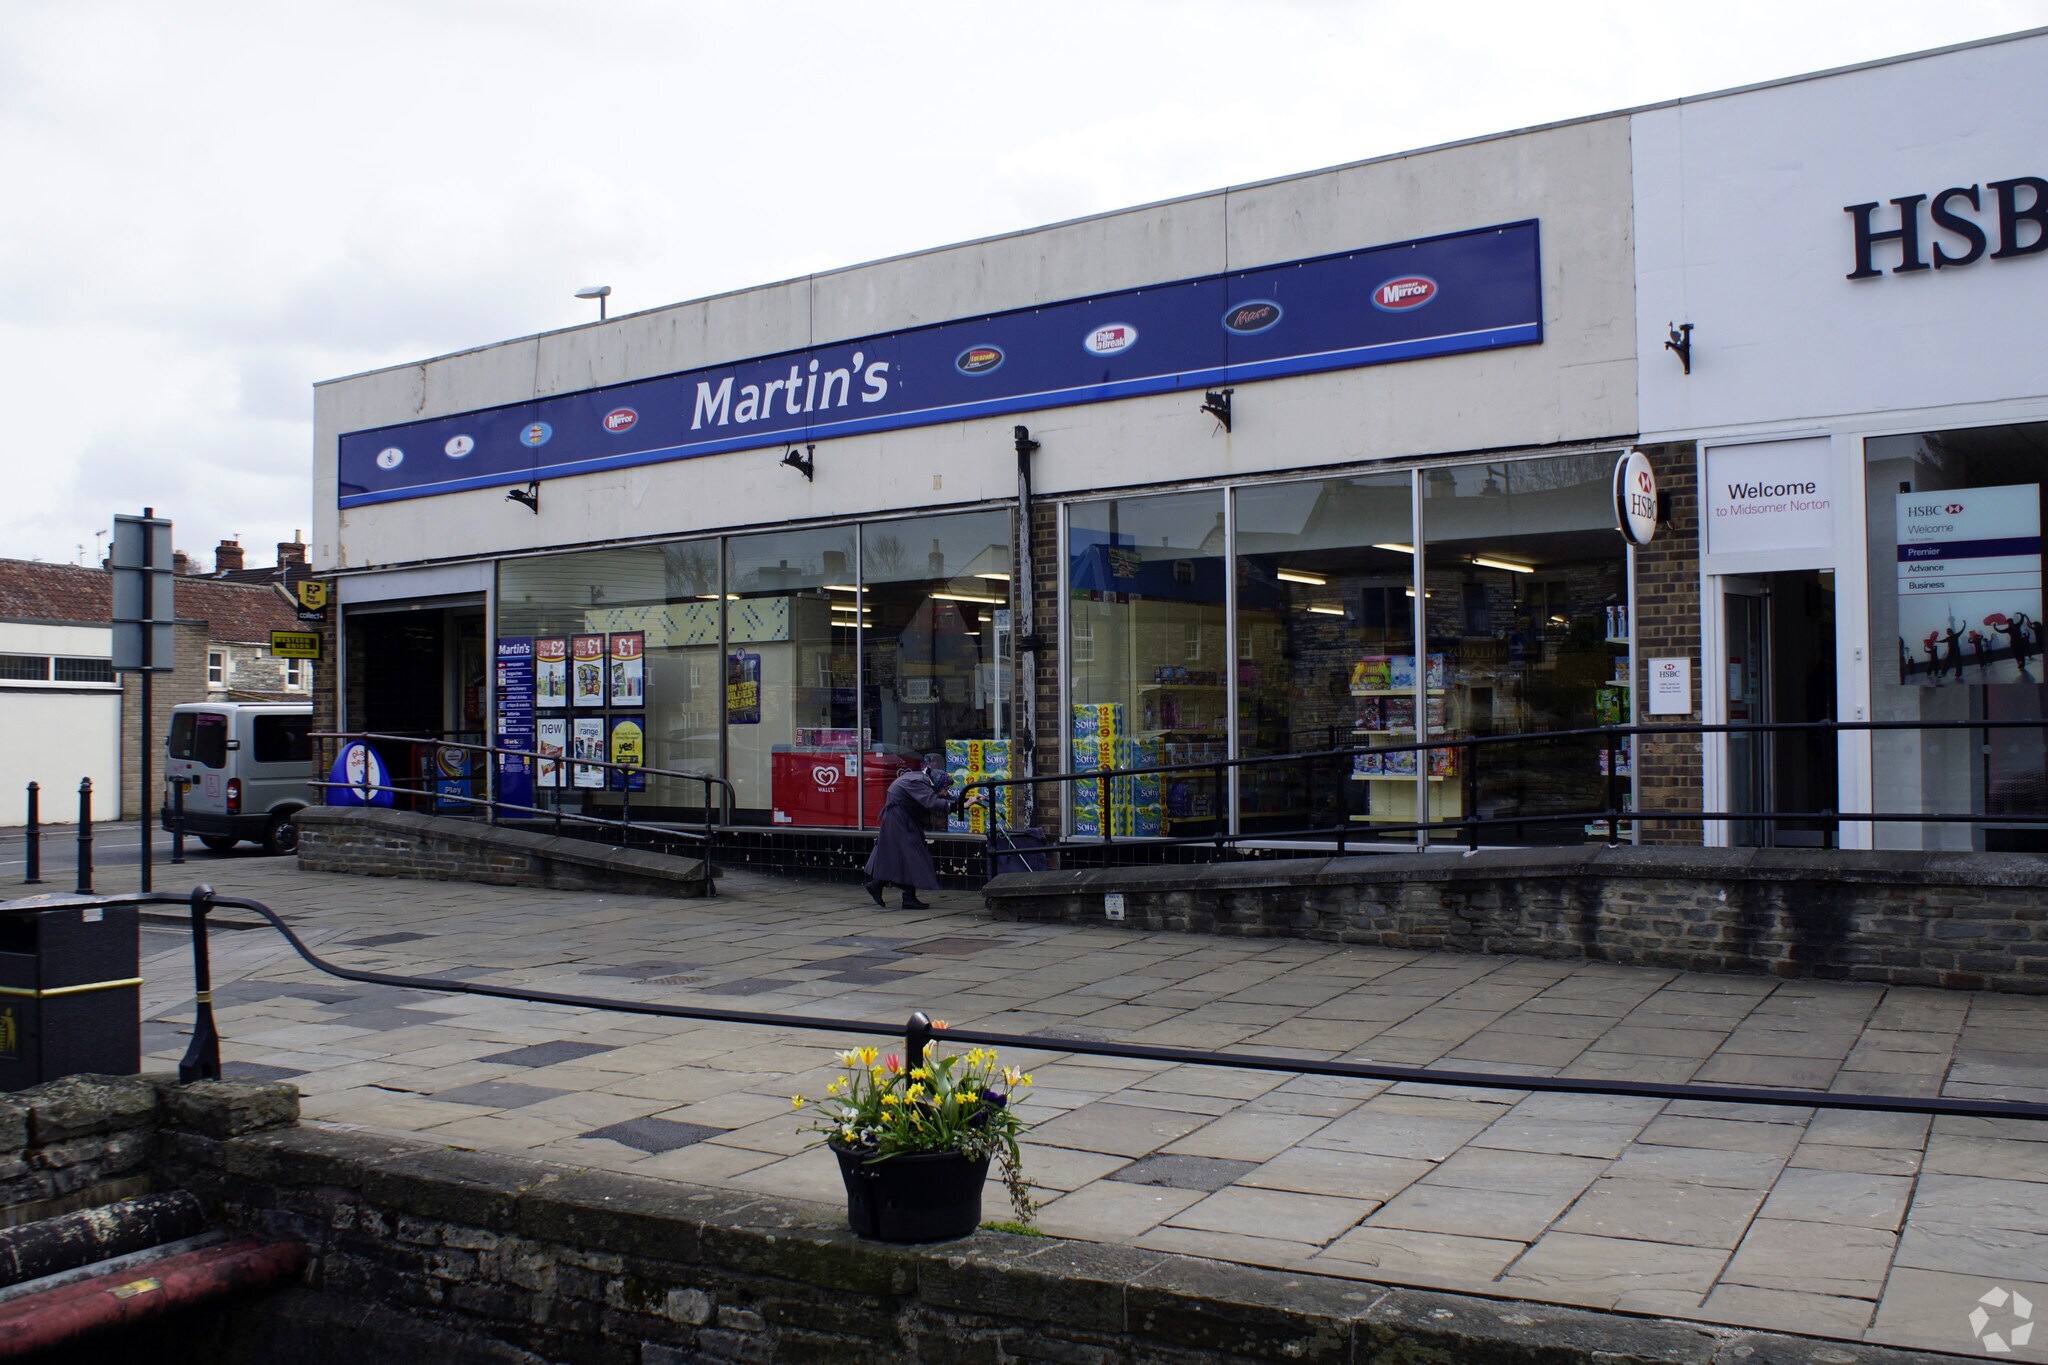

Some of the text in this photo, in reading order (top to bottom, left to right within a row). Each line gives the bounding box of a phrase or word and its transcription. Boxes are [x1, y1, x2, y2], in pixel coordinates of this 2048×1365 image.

[1843, 177, 2048, 280] HSB
[1384, 285, 1428, 303] Mirror
[1234, 307, 1270, 327] Mars
[1098, 332, 1115, 341] Take
[1103, 337, 1125, 348] Break
[690, 352, 889, 430] Martin's
[609, 415, 633, 428] Mirror
[1728, 481, 1816, 500] Welcome
[1631, 493, 1658, 521] HSBC
[1716, 499, 1830, 517] to Midsomer Norton
[1908, 505, 1942, 517] HSBC
[1908, 523, 1954, 535] Welcome
[1908, 547, 1940, 557] Premier
[1908, 564, 1944, 573] Advance
[1909, 581, 1945, 590] Business
[499, 643, 530, 655] Martin's
[540, 641, 550, 650] Any
[551, 641, 564, 656] £2
[576, 640, 586, 649] Any
[588, 639, 600, 654] £1
[619, 638, 634, 656] £1
[1659, 670, 1680, 678] HSBC
[1099, 706, 1108, 716] 12
[541, 723, 563, 734] new
[1075, 721, 1097, 730] Softy
[580, 728, 599, 737] range
[619, 740, 635, 754] yes!
[969, 743, 979, 753] 12
[1100, 742, 1109, 751] 12
[947, 755, 967, 764] Softy
[986, 755, 1007, 764] Softy
[1076, 756, 1097, 765] Softy
[1141, 754, 1156, 763] Softy
[970, 764, 979, 772] 9
[444, 786, 462, 795] Play
[1077, 789, 1096, 799] Softy
[1141, 789, 1158, 798] Softy
[1077, 823, 1098, 832] Softy
[1142, 822, 1160, 831] Softy
